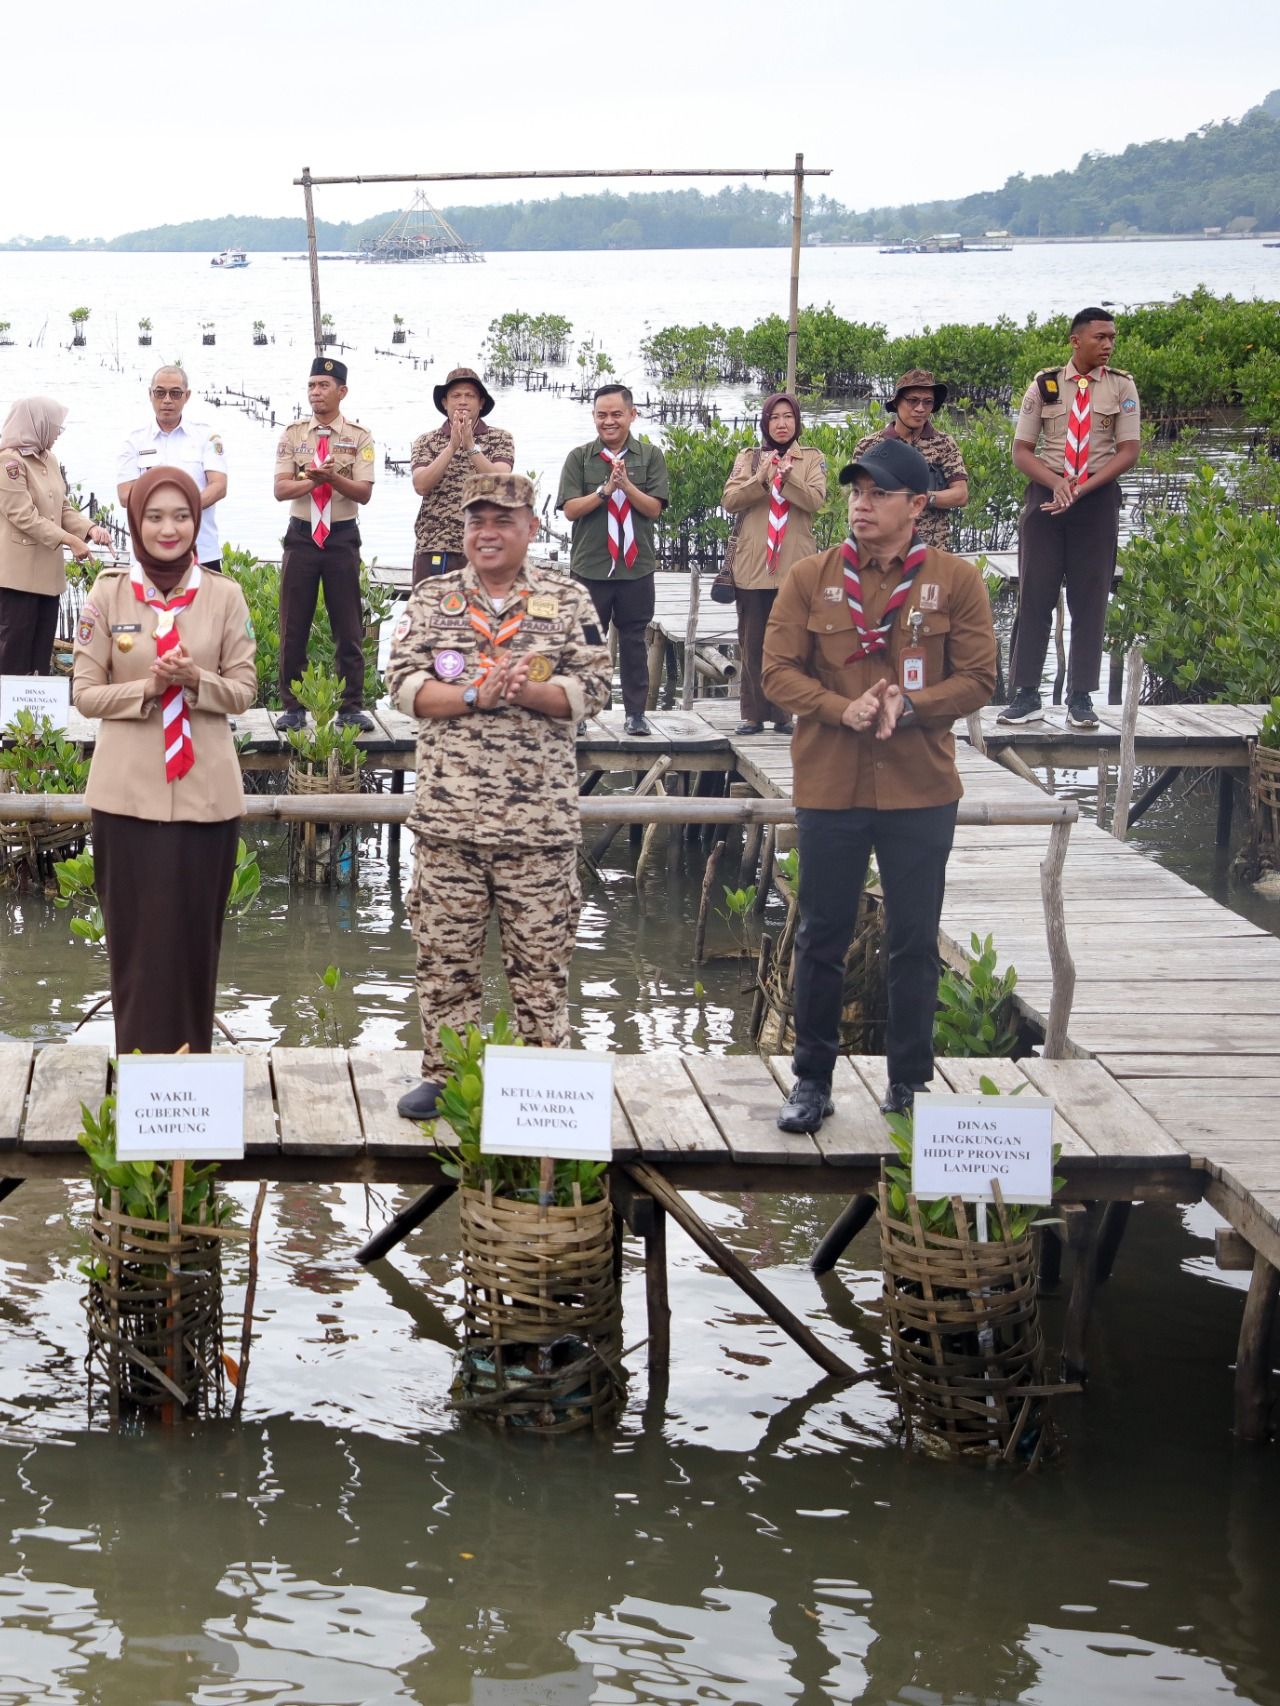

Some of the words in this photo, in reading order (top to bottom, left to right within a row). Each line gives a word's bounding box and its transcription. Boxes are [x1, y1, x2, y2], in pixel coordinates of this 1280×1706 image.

[150, 1091, 197, 1102] WAKIL
[501, 1087, 543, 1098] KETUA
[546, 1089, 594, 1101] HARIAN
[135, 1107, 210, 1118] GUBERNUR
[519, 1103, 575, 1114] KWARDA
[139, 1123, 207, 1134] LAMPUNG
[516, 1117, 578, 1129] LAMPUNG
[957, 1120, 997, 1131] DINAS
[932, 1134, 1022, 1146] LINGKUNGAN
[923, 1148, 965, 1158] HIDUP
[967, 1149, 1030, 1160] PROVINSI
[943, 1163, 1009, 1174] LAMPUNG
